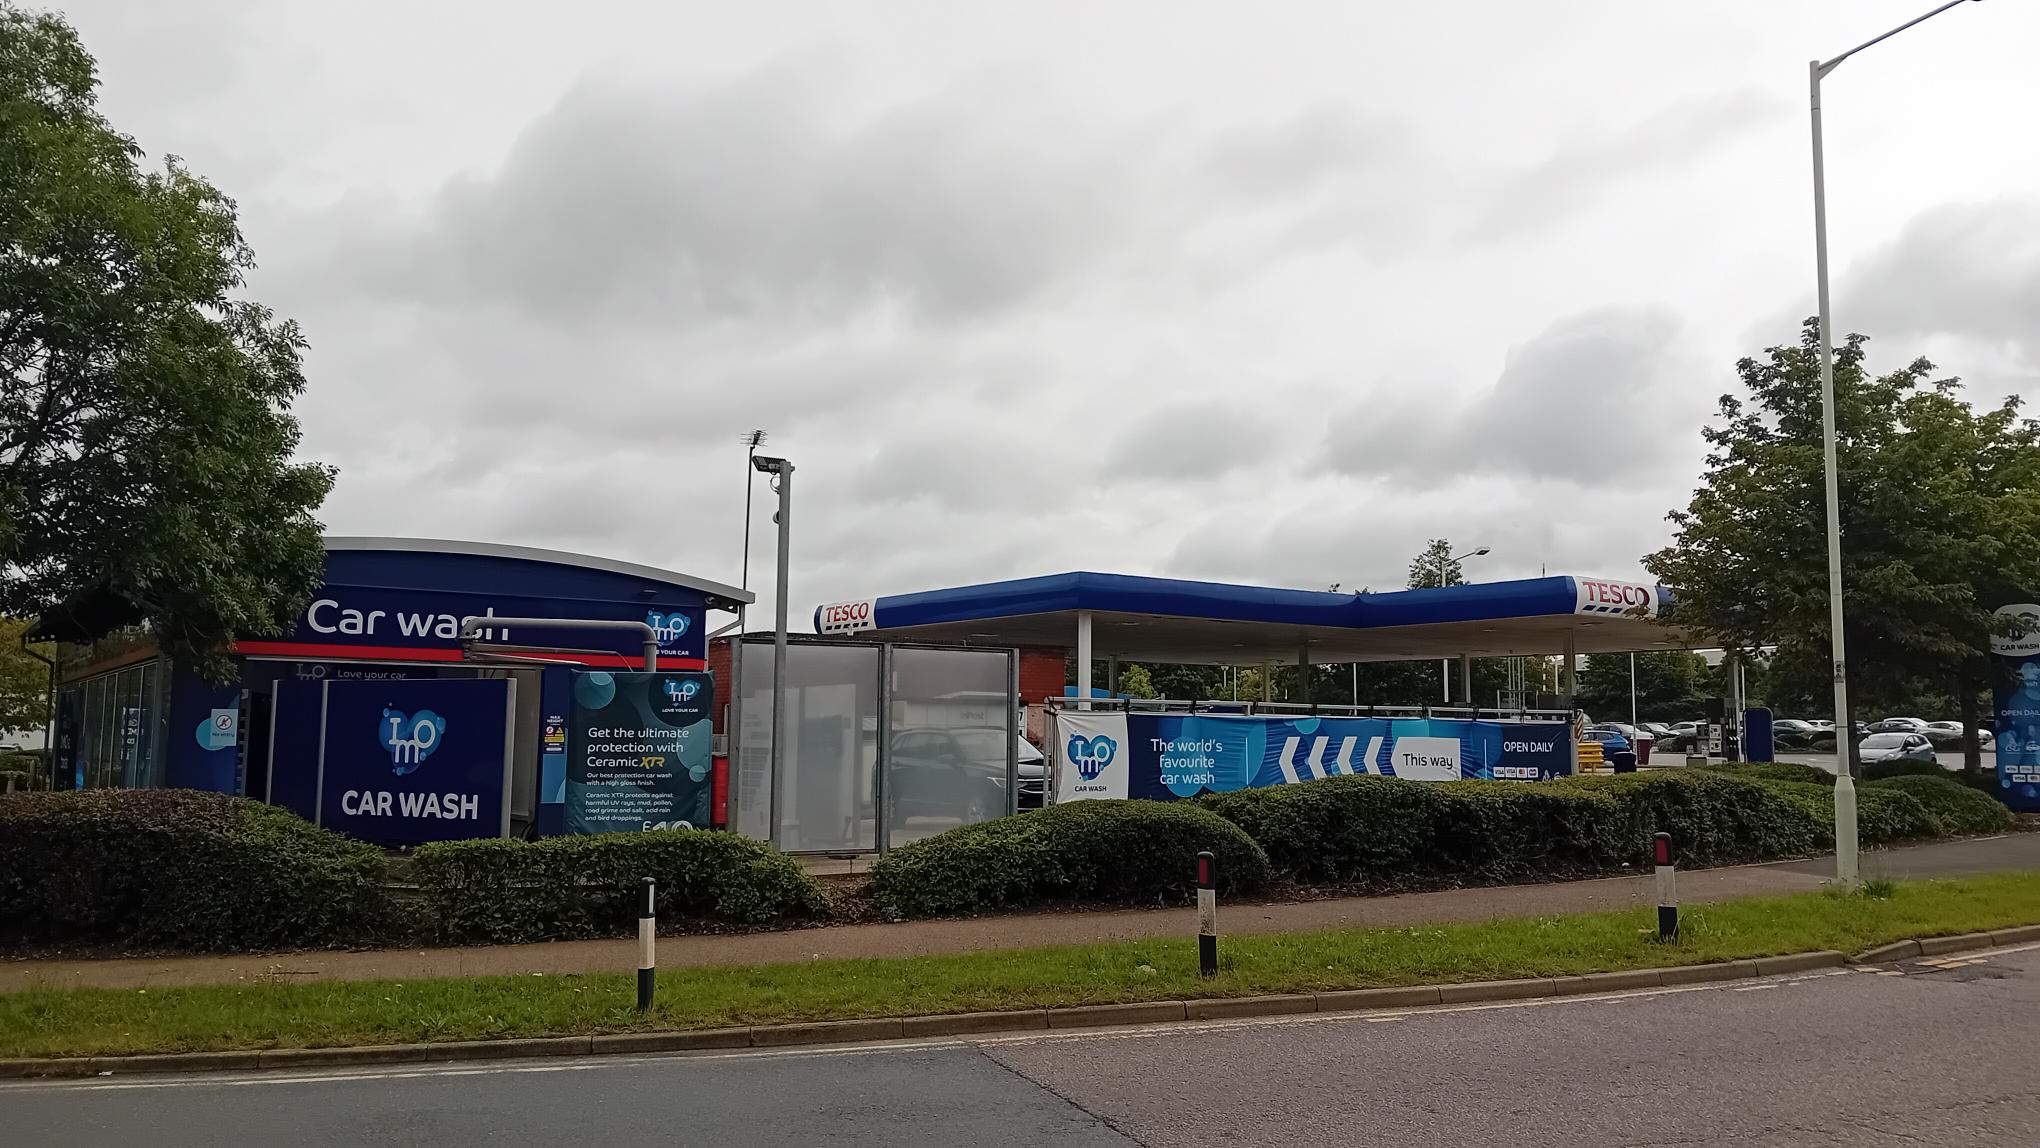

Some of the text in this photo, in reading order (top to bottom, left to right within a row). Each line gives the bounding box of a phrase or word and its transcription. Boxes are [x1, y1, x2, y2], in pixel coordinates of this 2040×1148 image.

[1582, 581, 1650, 606] TESCO
[826, 602, 869, 623] TESCO
[307, 599, 509, 641] Car wash
[337, 669, 407, 680] Love your car
[588, 727, 689, 738] Get the ultimate
[587, 742, 684, 754] protection with
[1150, 738, 1223, 752] The world's
[1504, 741, 1554, 753] OPEN DAILY
[586, 756, 665, 770] Ceramic XTR
[1160, 754, 1214, 768] favourite
[1402, 753, 1452, 770] This way
[1160, 770, 1214, 784] car wash
[341, 790, 479, 820] CAR WASH
